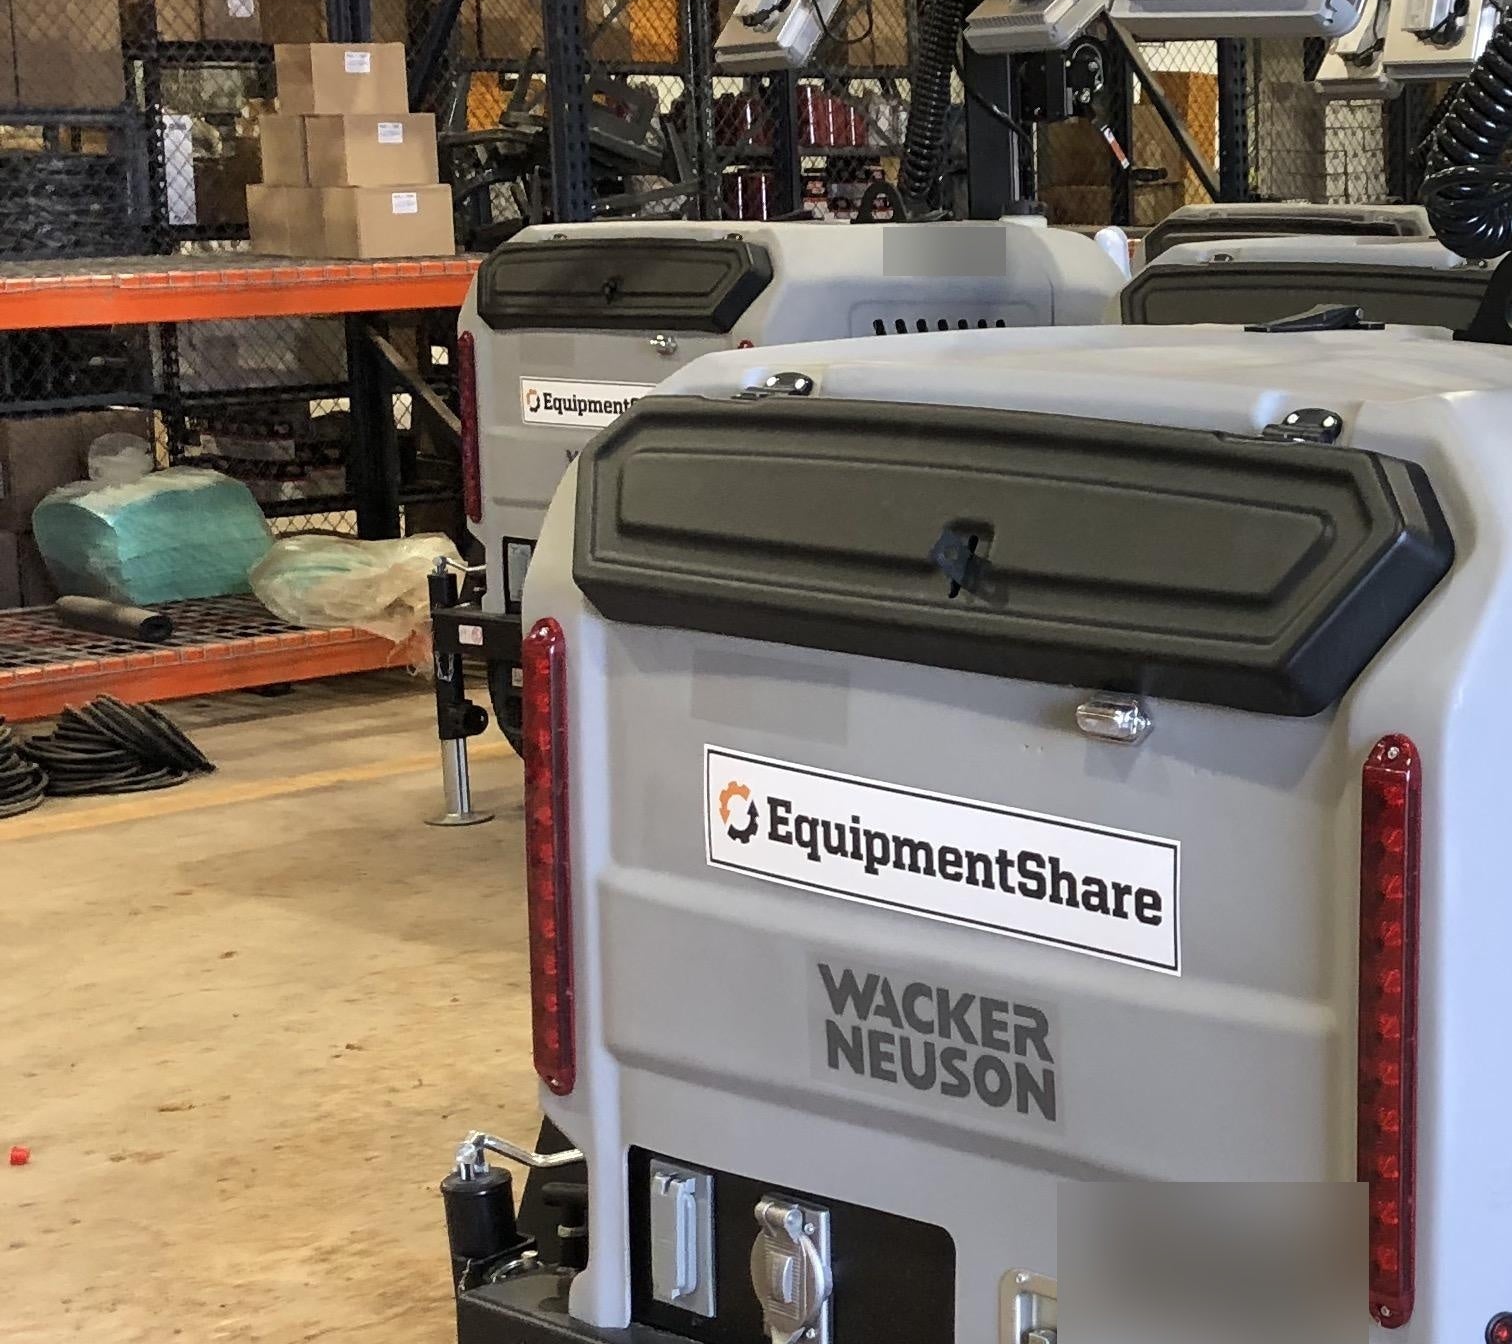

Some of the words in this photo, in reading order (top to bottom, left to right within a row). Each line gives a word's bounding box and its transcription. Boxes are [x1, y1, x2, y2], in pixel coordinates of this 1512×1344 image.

[542, 392, 639, 417] Equipment
[766, 795, 1162, 927] EquipmentShare
[816, 962, 1055, 1064] WACKER
[825, 1018, 1057, 1122] NEUSON
